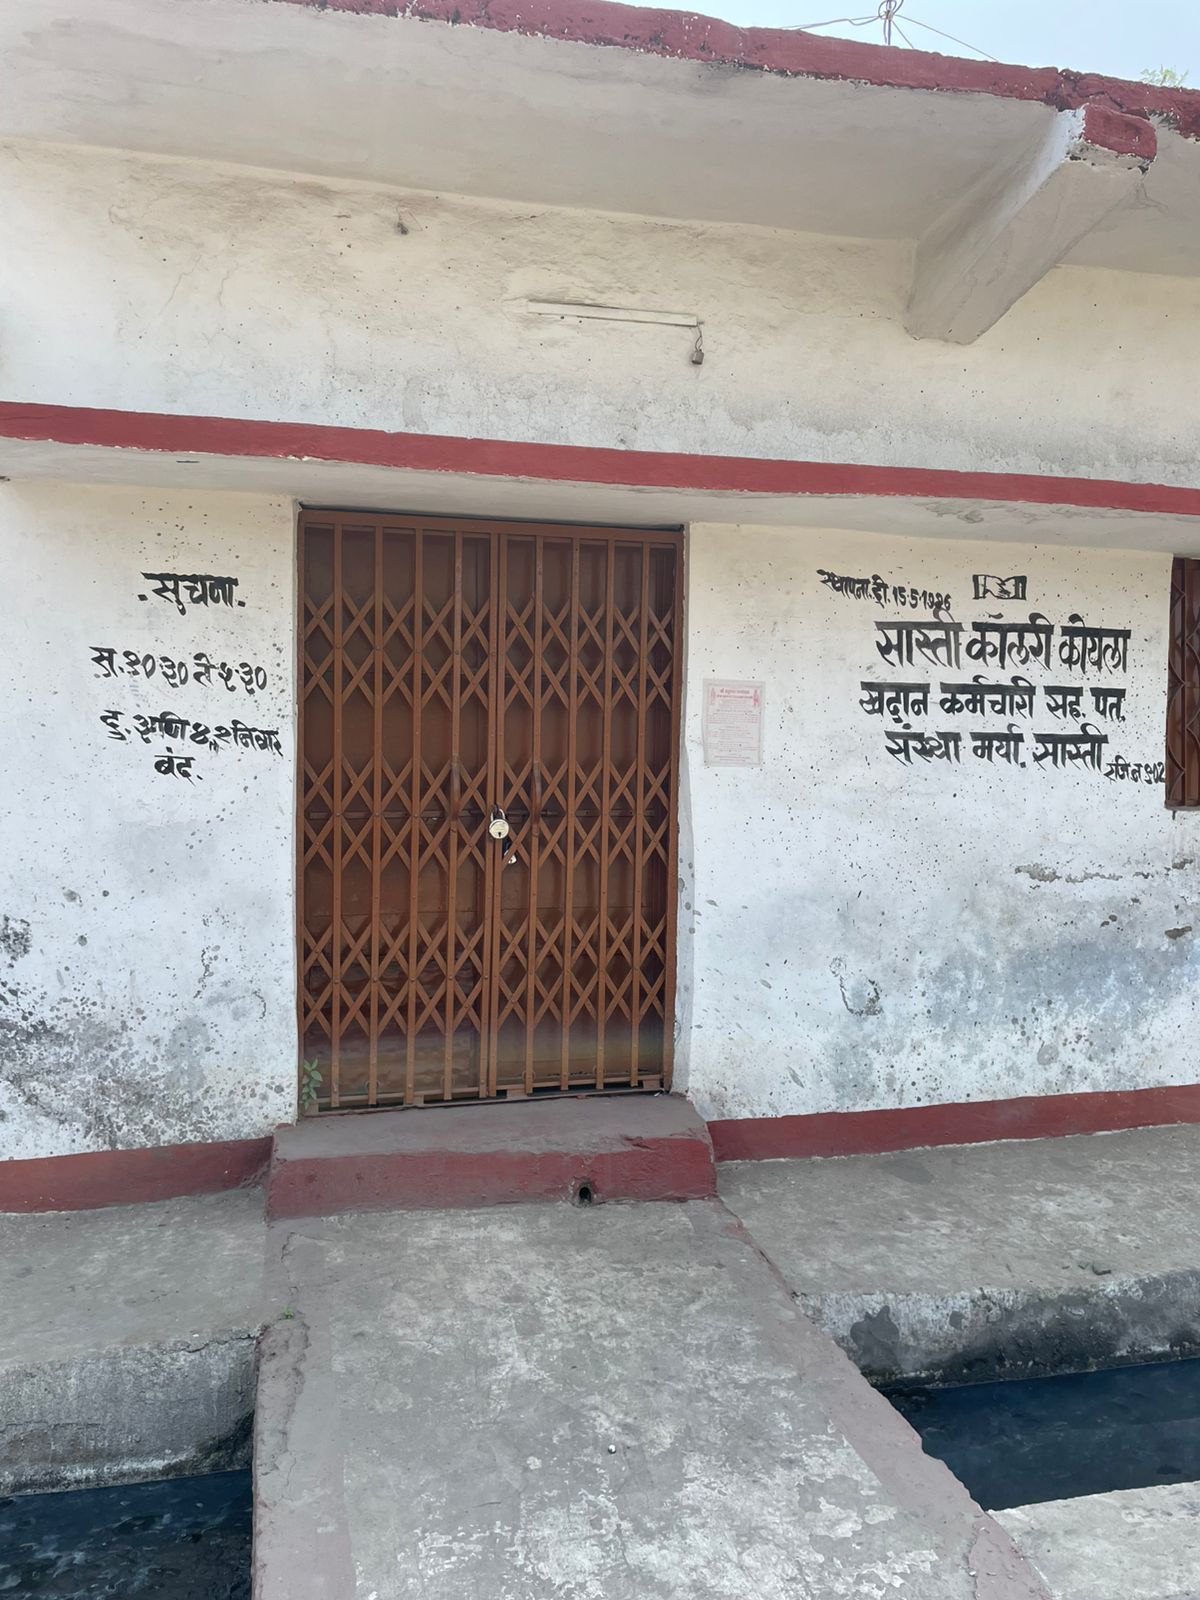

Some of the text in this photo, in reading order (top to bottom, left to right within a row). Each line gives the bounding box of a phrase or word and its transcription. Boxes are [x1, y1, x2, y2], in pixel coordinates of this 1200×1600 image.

[874, 607, 967, 671] सास्ती
[1058, 613, 1132, 675] कोयला
[939, 674, 1037, 718] कर्मचारी
[884, 722, 962, 767] संस्था
[1032, 722, 1109, 772] सास्ती
